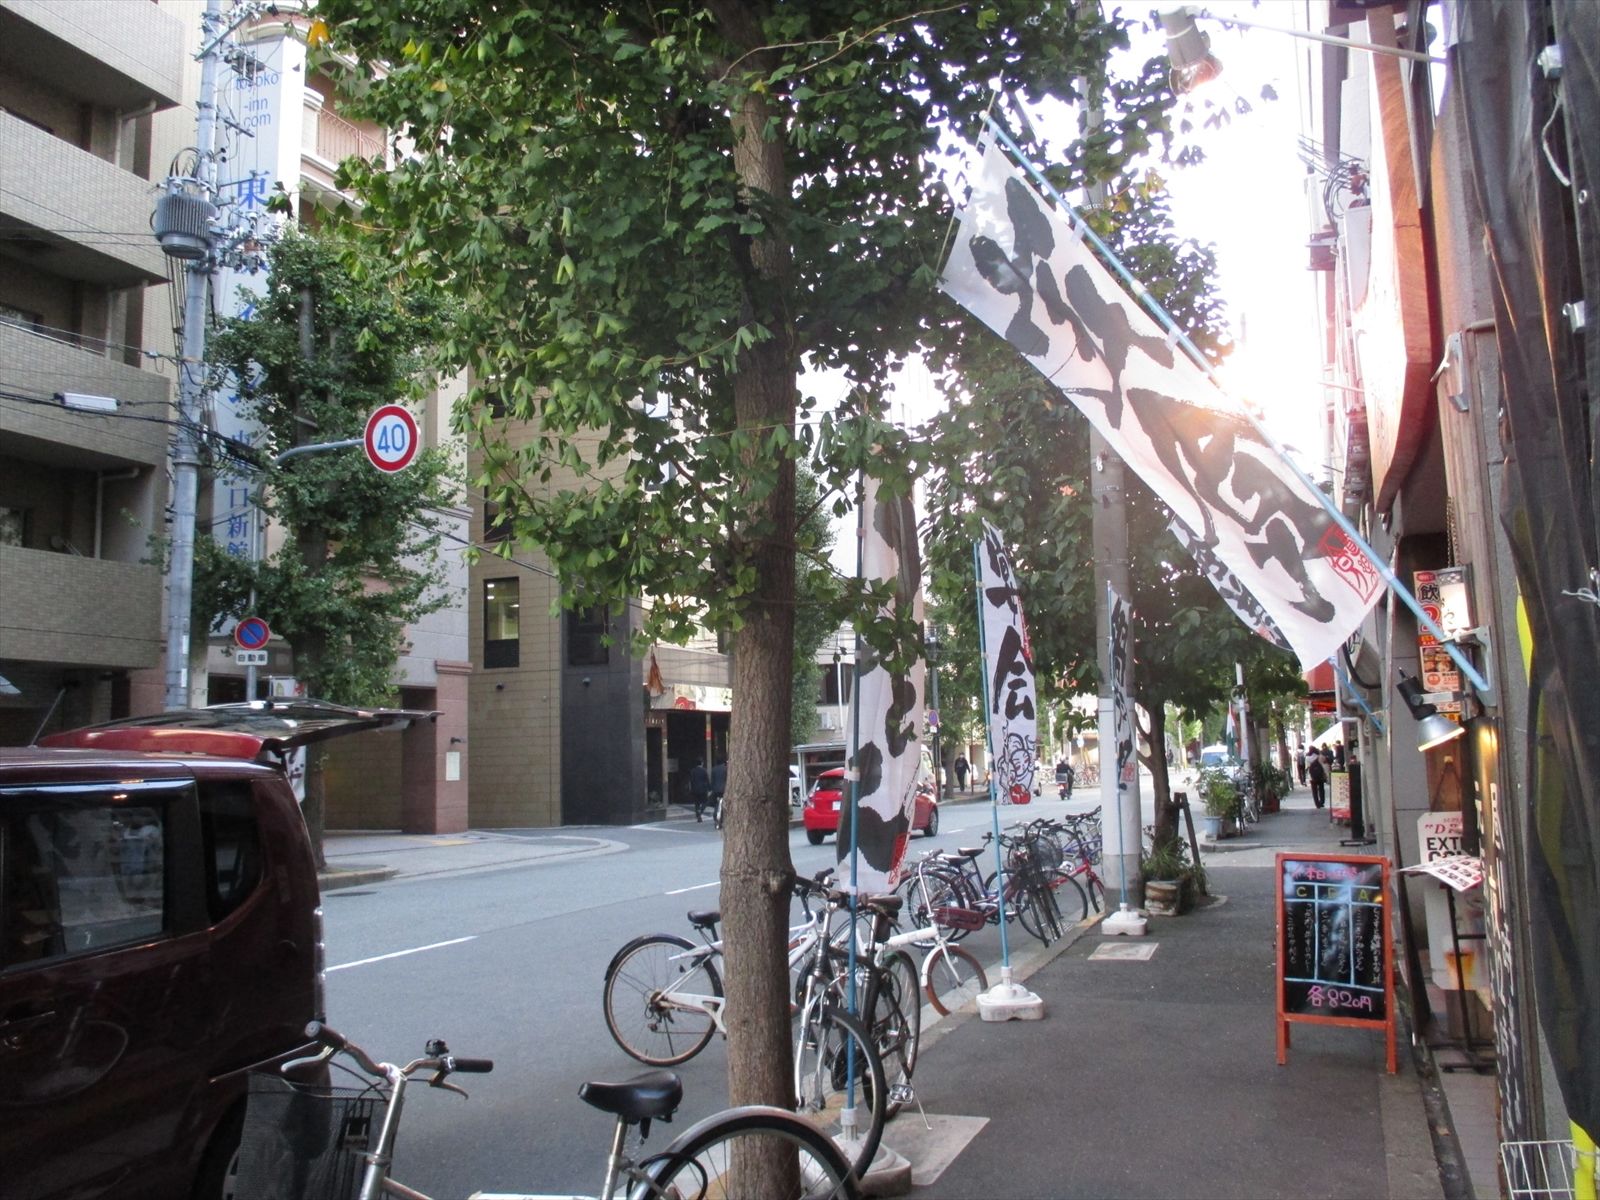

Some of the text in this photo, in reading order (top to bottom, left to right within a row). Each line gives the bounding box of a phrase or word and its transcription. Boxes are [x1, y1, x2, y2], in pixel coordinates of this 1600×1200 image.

[378, 424, 405, 453] 40
[1296, 886, 1307, 897] C
[1358, 888, 1369, 903] A
[1307, 985, 1373, 1013] 各820円
